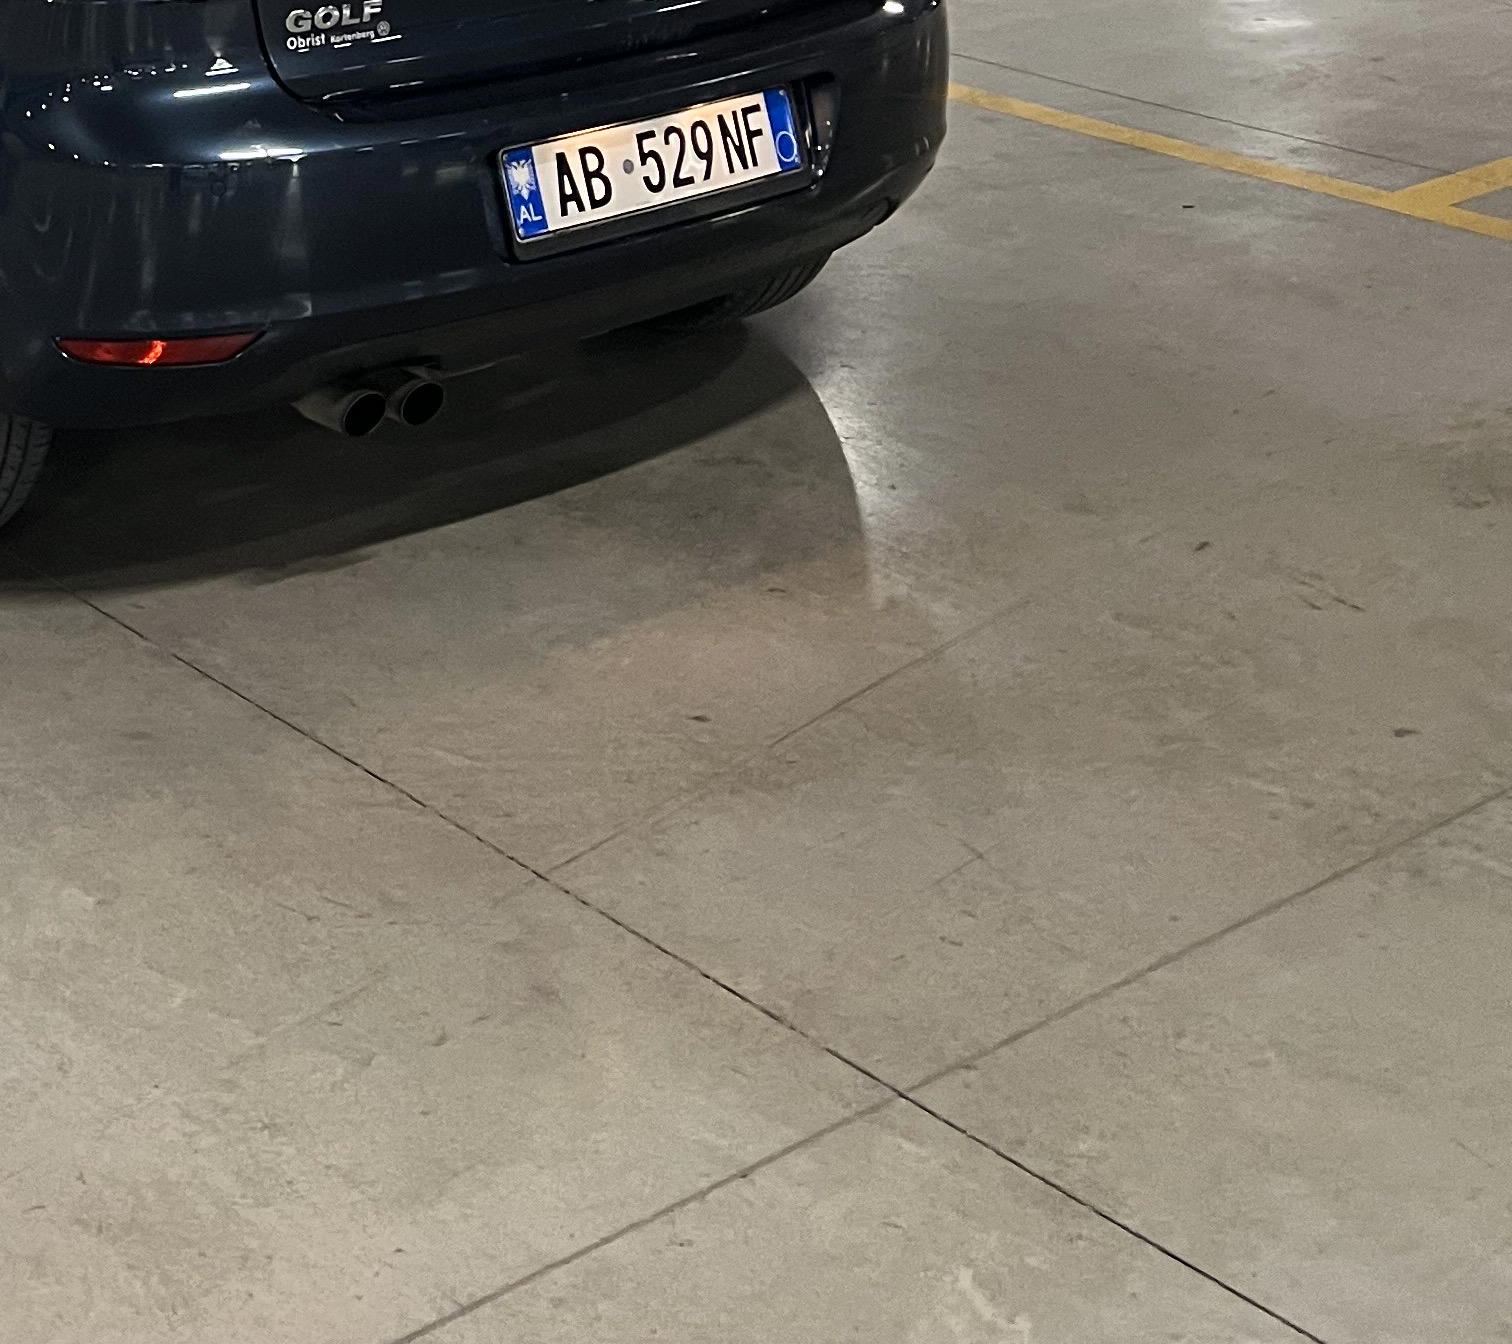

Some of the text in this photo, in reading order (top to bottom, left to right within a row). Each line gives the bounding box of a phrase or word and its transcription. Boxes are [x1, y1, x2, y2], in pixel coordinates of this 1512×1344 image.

[286, 33, 326, 50] Obrist
[554, 145, 613, 217] AB
[518, 204, 543, 225] AL
